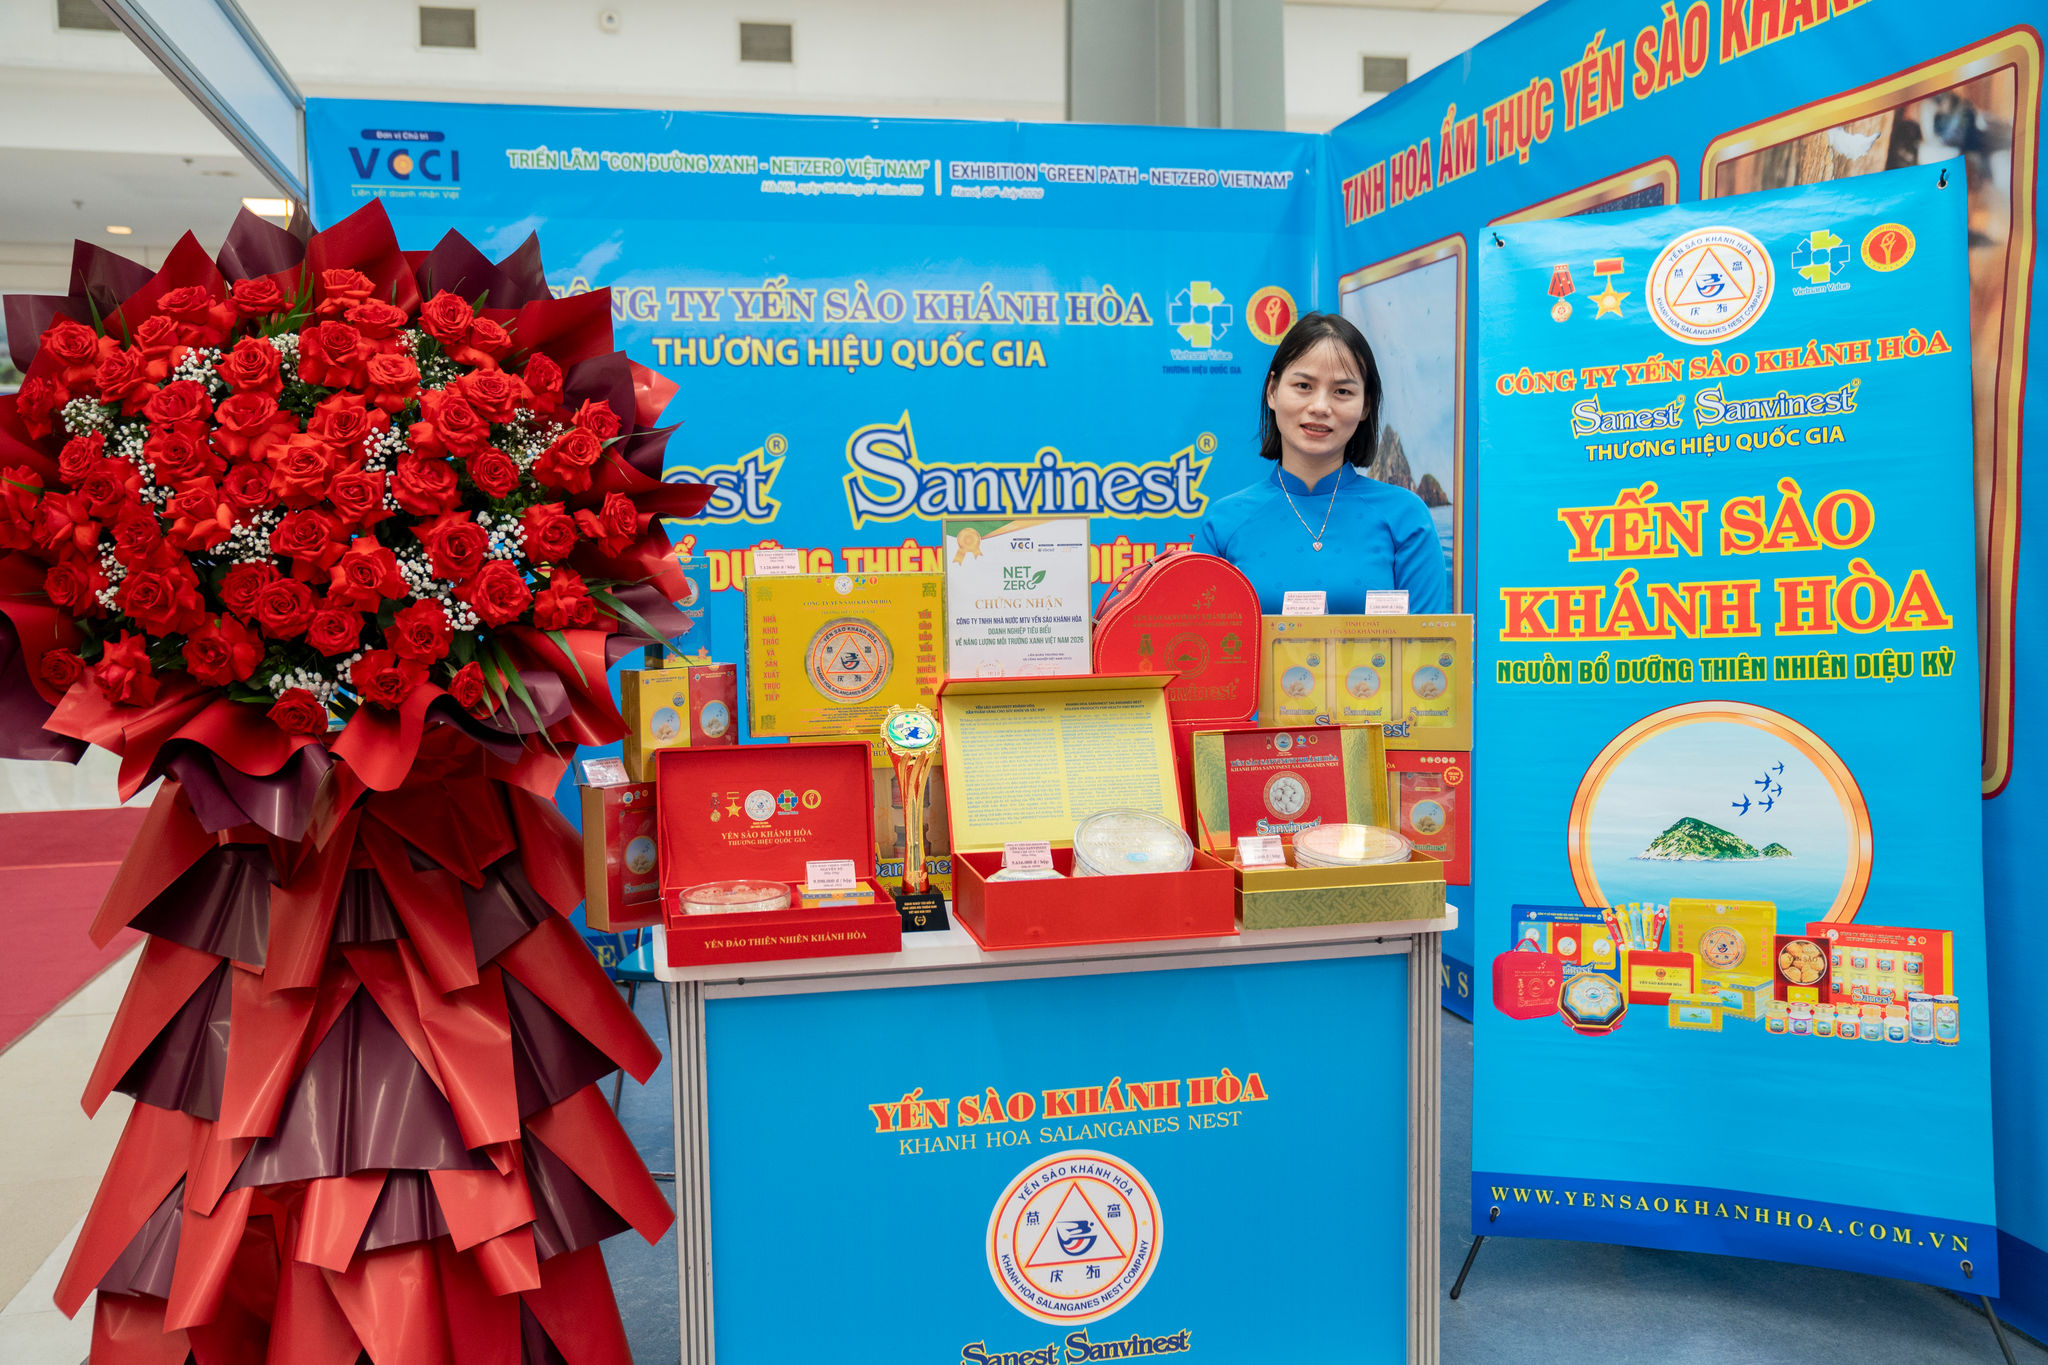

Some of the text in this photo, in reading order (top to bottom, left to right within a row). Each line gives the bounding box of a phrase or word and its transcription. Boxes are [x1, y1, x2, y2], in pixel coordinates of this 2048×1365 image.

[1342, 160, 1385, 228] TINH
[1390, 138, 1433, 208] HOA
[1437, 102, 1478, 187] ẨM
[1483, 76, 1554, 166] THỰC
[1560, 28, 1625, 132] YẾN
[1632, 0, 1710, 100] SÀO
[348, 147, 460, 182] VCCI
[507, 145, 558, 169] TRIỂN
[561, 148, 599, 170] LÃM
[647, 150, 707, 172] ĐƯỜNG
[709, 155, 758, 174] XANH
[770, 156, 843, 176] NETZERO
[846, 156, 884, 180] VIỆT
[950, 163, 1036, 181] EXHIBITION
[1098, 168, 1138, 184] PATH
[1150, 168, 1217, 187] NETZERO
[1705, 235, 1735, 245] KHÁNH
[666, 275, 1153, 327] TY YẾN SÀO KHÁNH HÒA
[1792, 282, 1851, 297] Vietnam Value
[1680, 324, 1727, 336] SALANGANES
[1727, 315, 1745, 330] NEST
[1744, 285, 1764, 317] COMPANY
[651, 331, 1047, 374] THƯƠNG HIỆU QUỐC GIA
[1171, 349, 1233, 361] Vietnam Value
[1496, 328, 1953, 396] CÔNG TY YẾN SÀO KHÁNH HÒA
[1585, 425, 1846, 462] THƯƠNG HIỆU QUỐC GIA
[1558, 476, 1875, 563] YẾN SÀO
[1003, 566, 1031, 579] NET
[1003, 579, 1036, 591] ZERO
[975, 595, 1063, 611] CHỨNG NHẬN
[1500, 558, 1954, 643] KHÁNH HÒA
[988, 627, 1006, 635] DOANH
[1007, 626, 1026, 635] NGHIỆP
[1029, 637, 1044, 645] XANH
[1057, 636, 1069, 644] NAM
[1496, 645, 1956, 685] NGUỒN BỔ DƯỠNG THIÊN NHIÊN DIỆU KỲ
[721, 827, 813, 840] YẾN SÀO KHÁNH HÒA
[704, 938, 724, 949] YẾN
[749, 935, 777, 947] THIÊN
[779, 933, 810, 945] NHIÊN
[811, 931, 845, 943] KHÁNH
[848, 930, 867, 941] HÒA
[869, 1067, 1269, 1133] YẾN SÀO KHÁNH HÒA
[899, 1111, 1243, 1156] KHANH HOA SALANGANES NEST
[1018, 1163, 1134, 1202] YẾN SÀO KHÁNH HÒA
[1490, 1185, 1970, 1253] WWW.YENSAOKHANHHOA.COM.VN
[1001, 1240, 1149, 1312] KHANH HOA SALANGANES NEST COMPANY
[1064, 1327, 1192, 1364] Sanvinest
